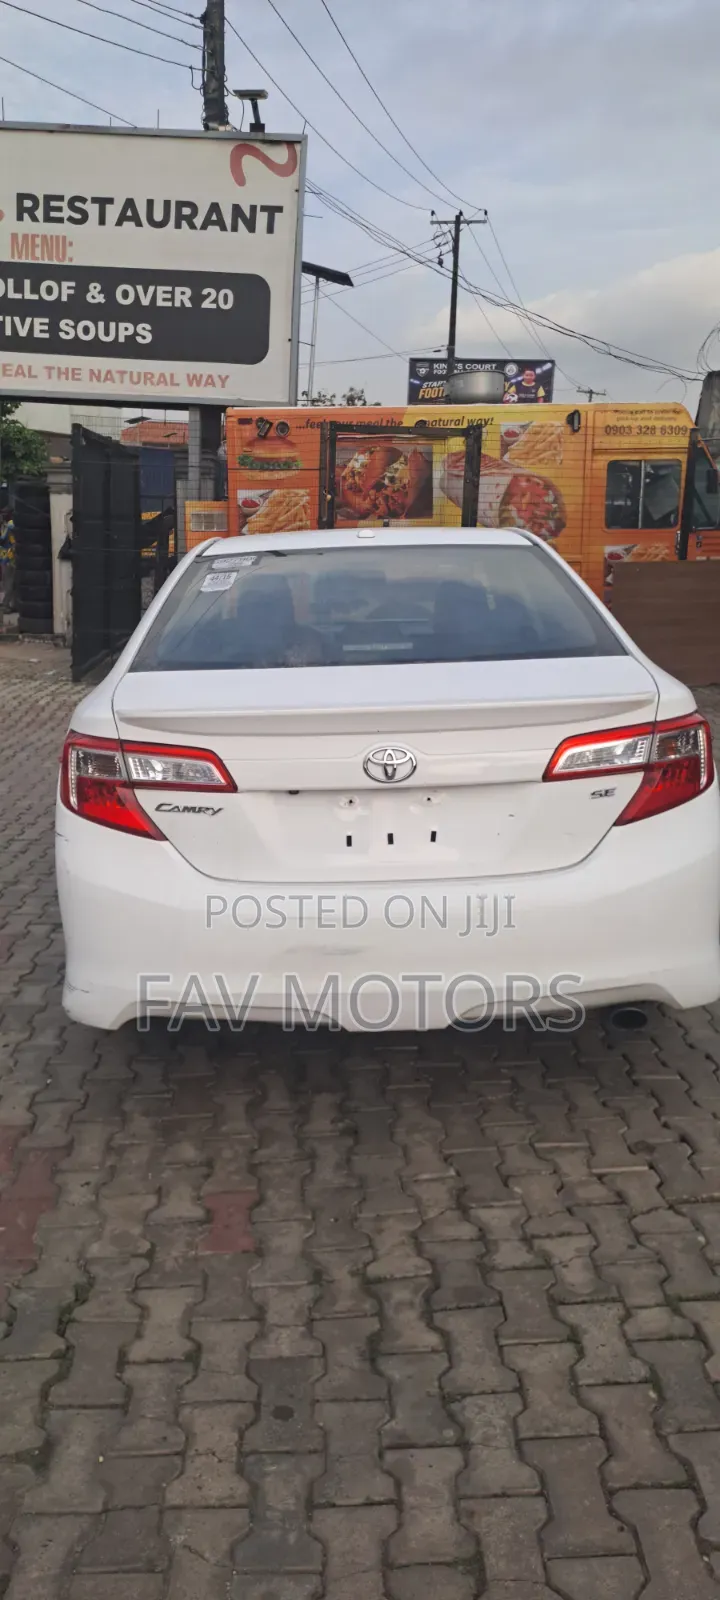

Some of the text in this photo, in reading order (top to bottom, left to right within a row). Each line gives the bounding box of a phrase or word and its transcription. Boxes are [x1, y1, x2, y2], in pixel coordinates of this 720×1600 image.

[16, 192, 284, 234] RESTAURANT
[10, 232, 74, 263] MENU:
[0, 278, 234, 310] LLOF & OVER 20
[0, 315, 153, 344] IVE SOUPS
[44, 365, 82, 382] THE
[88, 368, 180, 387] NATURAL
[186, 373, 230, 389] WAY
[605, 425, 632, 436] 0903
[590, 787, 617, 800] SE
[154, 802, 224, 816] CAMRY
